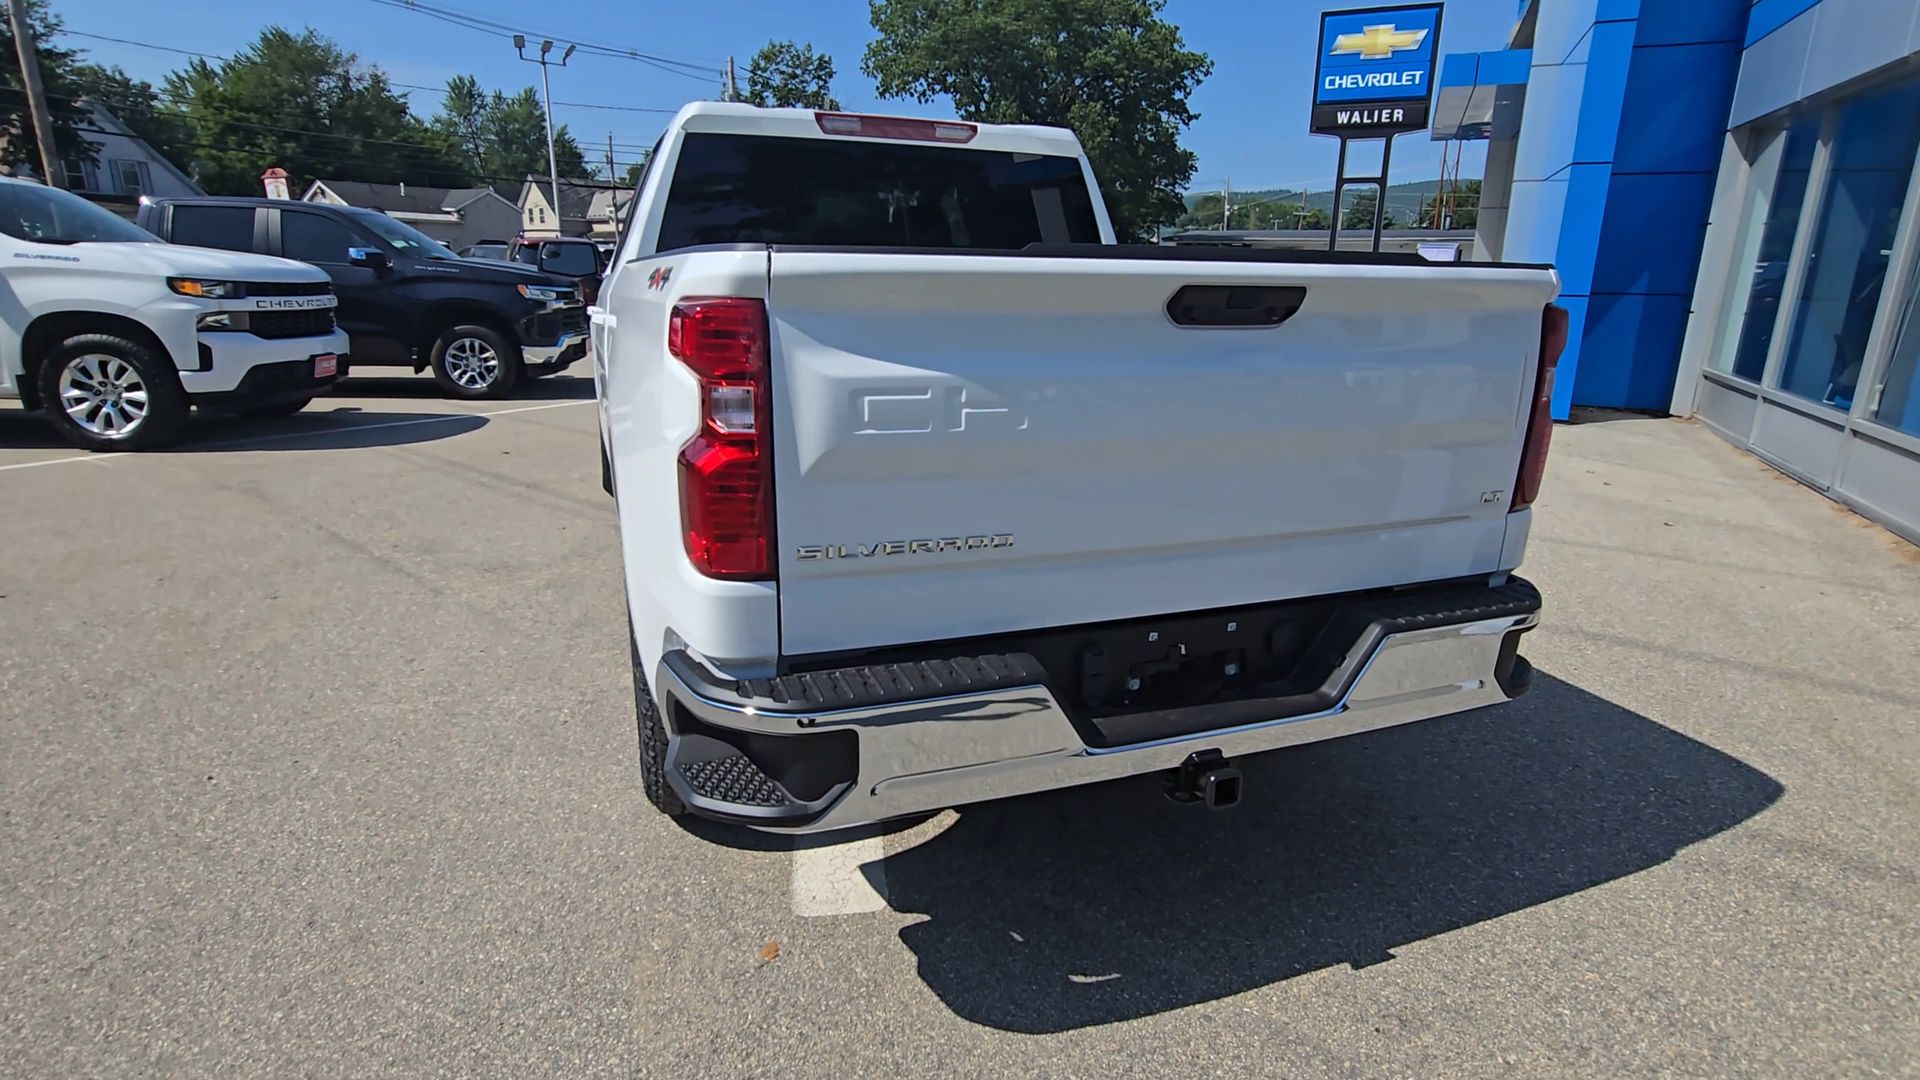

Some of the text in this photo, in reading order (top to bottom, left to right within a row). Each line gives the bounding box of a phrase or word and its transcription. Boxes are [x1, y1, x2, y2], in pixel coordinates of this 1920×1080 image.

[1324, 70, 1424, 90] CHEVROLET
[1336, 108, 1404, 125] WALIER
[1480, 489, 1504, 504] LT
[797, 533, 1015, 561] SILVERADO
